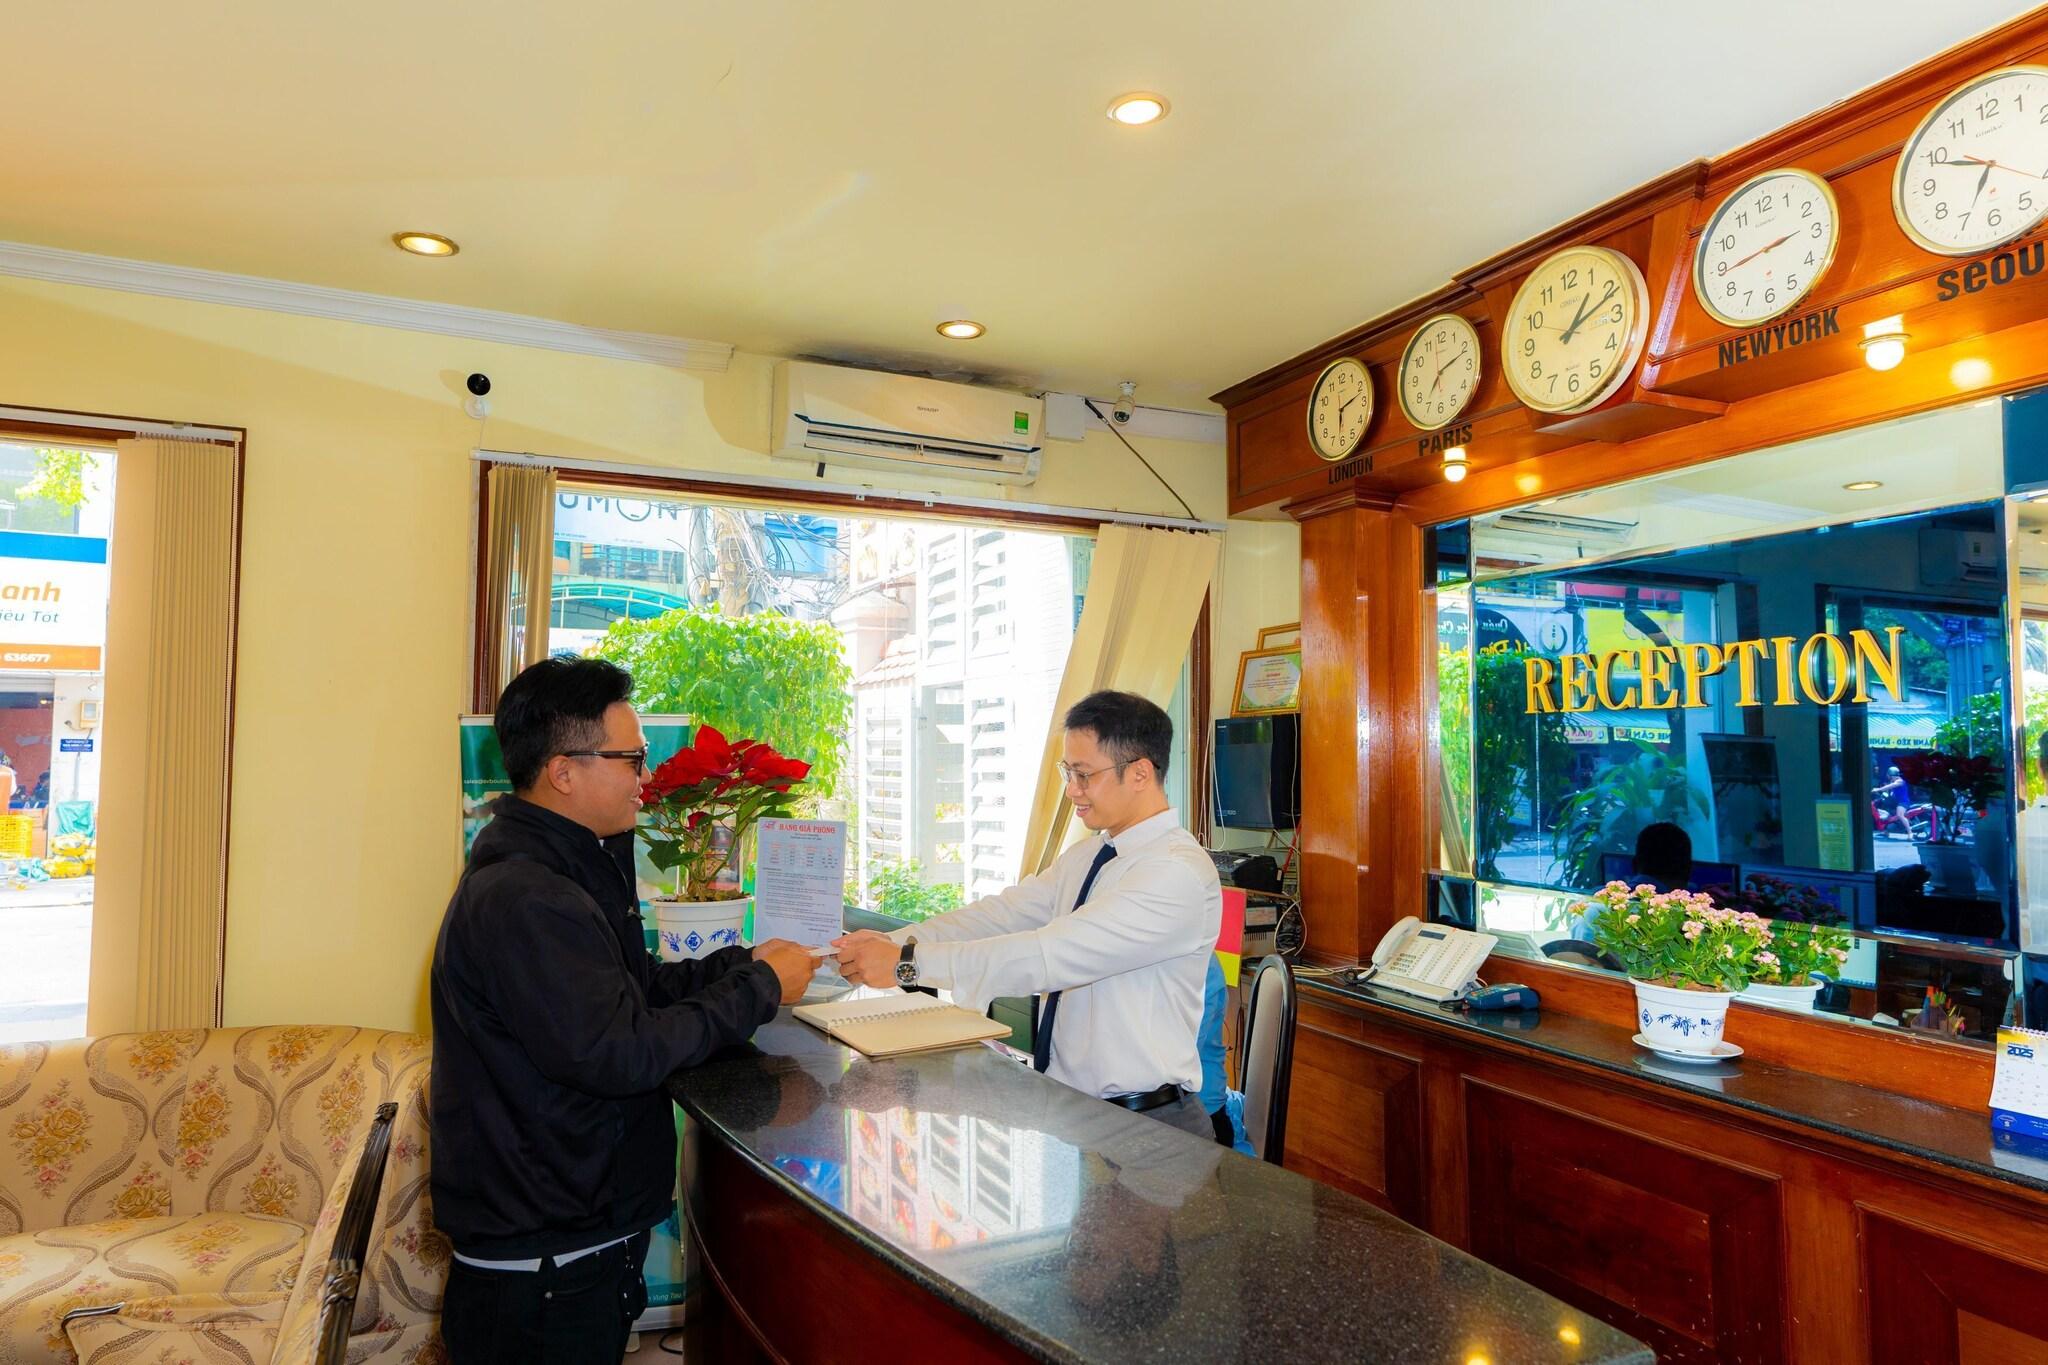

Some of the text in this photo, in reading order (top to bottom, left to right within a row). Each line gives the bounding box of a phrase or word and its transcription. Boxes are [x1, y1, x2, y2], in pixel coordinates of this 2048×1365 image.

[1976, 98, 2000, 121] 12
[2014, 94, 2023, 112] 1
[1948, 118, 1965, 139] 11
[1926, 147, 1947, 167] 10
[1923, 178, 1936, 196] 9
[1755, 195, 1772, 214] 12
[1782, 193, 1789, 208] 1
[2018, 191, 2033, 211] 5
[1801, 201, 1813, 218] 2
[1935, 202, 1948, 220] 8
[1987, 209, 2002, 227] 6
[1735, 211, 1749, 229] 11
[1958, 212, 1971, 232] 7
[1811, 222, 1822, 239] 3
[1720, 234, 1735, 252] 10
[1803, 251, 1815, 266] 4
[1588, 268, 1594, 285] 1
[1717, 261, 1727, 277] 9
[1560, 269, 1578, 291] 12
[1787, 274, 1798, 290] 5
[1540, 286, 1552, 306] 11
[1603, 280, 1615, 300] 2
[1726, 282, 1737, 297] 8
[1764, 288, 1775, 303] 6
[1744, 290, 1753, 307] 7
[1527, 311, 1543, 331] 10
[1611, 304, 1623, 323] 3
[1436, 331, 1447, 344] 12
[1604, 332, 1617, 350] 4
[1718, 306, 1840, 369] NEWYORK
[1425, 341, 1432, 352] 11
[1461, 341, 1468, 353] 2
[1524, 338, 1535, 357] 9
[1415, 356, 1424, 368] 10
[1466, 358, 1472, 371] 3
[1531, 360, 1542, 379] 8
[1590, 359, 1601, 378] 5
[1329, 382, 1335, 392] 11
[1338, 373, 1346, 384] 12
[1358, 381, 1363, 392] 2
[1412, 376, 1419, 387] 9
[1460, 379, 1467, 391] 4
[1547, 374, 1558, 393] 7
[1568, 373, 1580, 392] 6
[1320, 396, 1329, 407] 10
[1362, 396, 1367, 407] 3
[1417, 392, 1423, 404] 8
[1450, 394, 1457, 406] 5
[1426, 402, 1432, 413] 7
[1437, 402, 1444, 414] 6
[1320, 413, 1325, 424] 9
[1358, 414, 1363, 424] 4
[1323, 428, 1328, 438] 8
[1331, 435, 1336, 446] 7
[1340, 436, 1346, 446] 6
[1350, 428, 1355, 440] 5
[1418, 424, 1472, 457] PARIS
[1328, 456, 1373, 484] LONDON
[1523, 626, 1905, 714] RECEPTION
[2007, 1045, 2034, 1059] 2025
